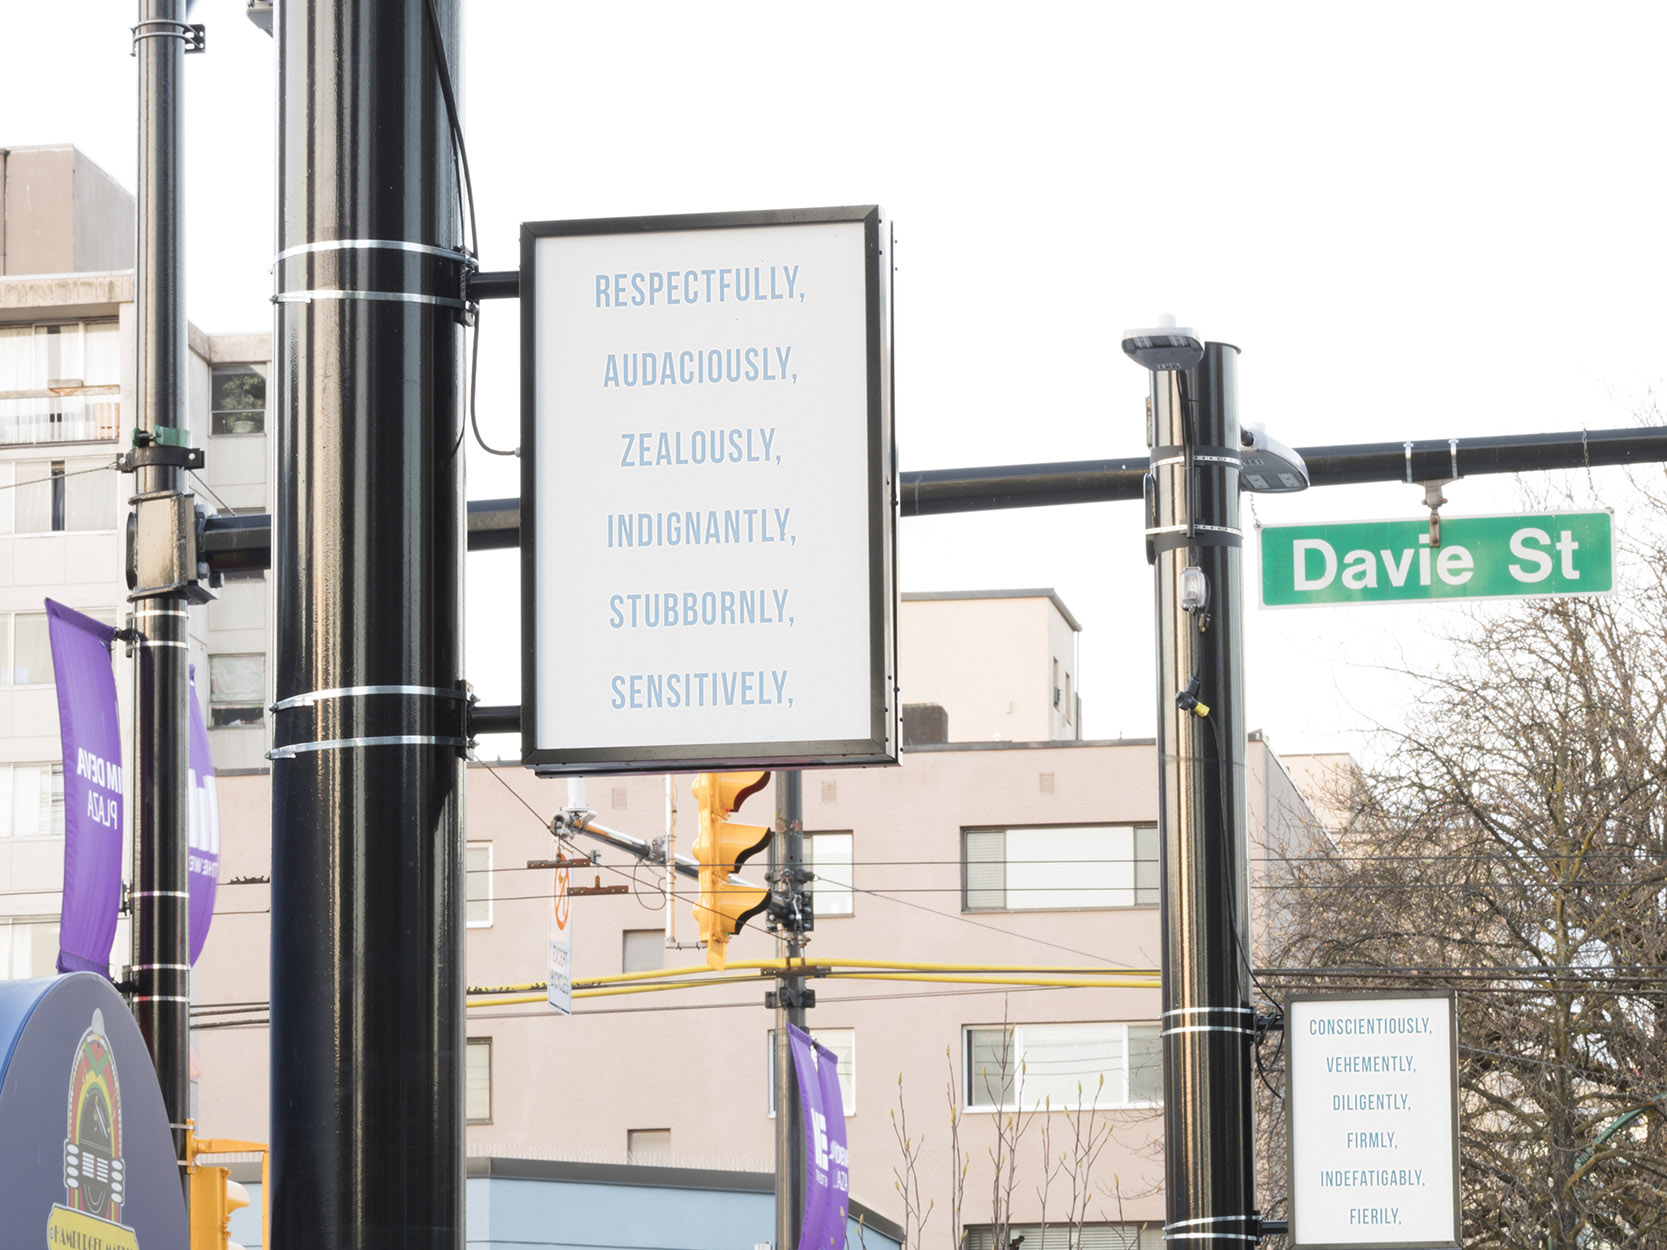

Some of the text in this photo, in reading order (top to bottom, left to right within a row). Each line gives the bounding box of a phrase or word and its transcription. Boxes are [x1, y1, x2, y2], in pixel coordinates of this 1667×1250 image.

[594, 265, 806, 309] RESPECTFULLY,
[603, 346, 798, 388] AUDACIOUSLY,
[621, 427, 782, 467] ZEALOUSLY,
[607, 508, 797, 549] INDIGNANTLY,
[1292, 527, 1580, 592] Davie St
[609, 589, 795, 629] STUBBORNLY,
[610, 670, 795, 710] SENSITIVELY,
[1309, 1017, 1433, 1036] CONSCIENTIOUSLY,
[1326, 1055, 1417, 1074] VEHEMENTLY,
[1332, 1094, 1411, 1112] DILIGENTLY,
[1347, 1131, 1398, 1149] FIRMLY,
[1320, 1169, 1426, 1188] INDEFATIGABLY,
[1350, 1207, 1402, 1226] FIERILY,
